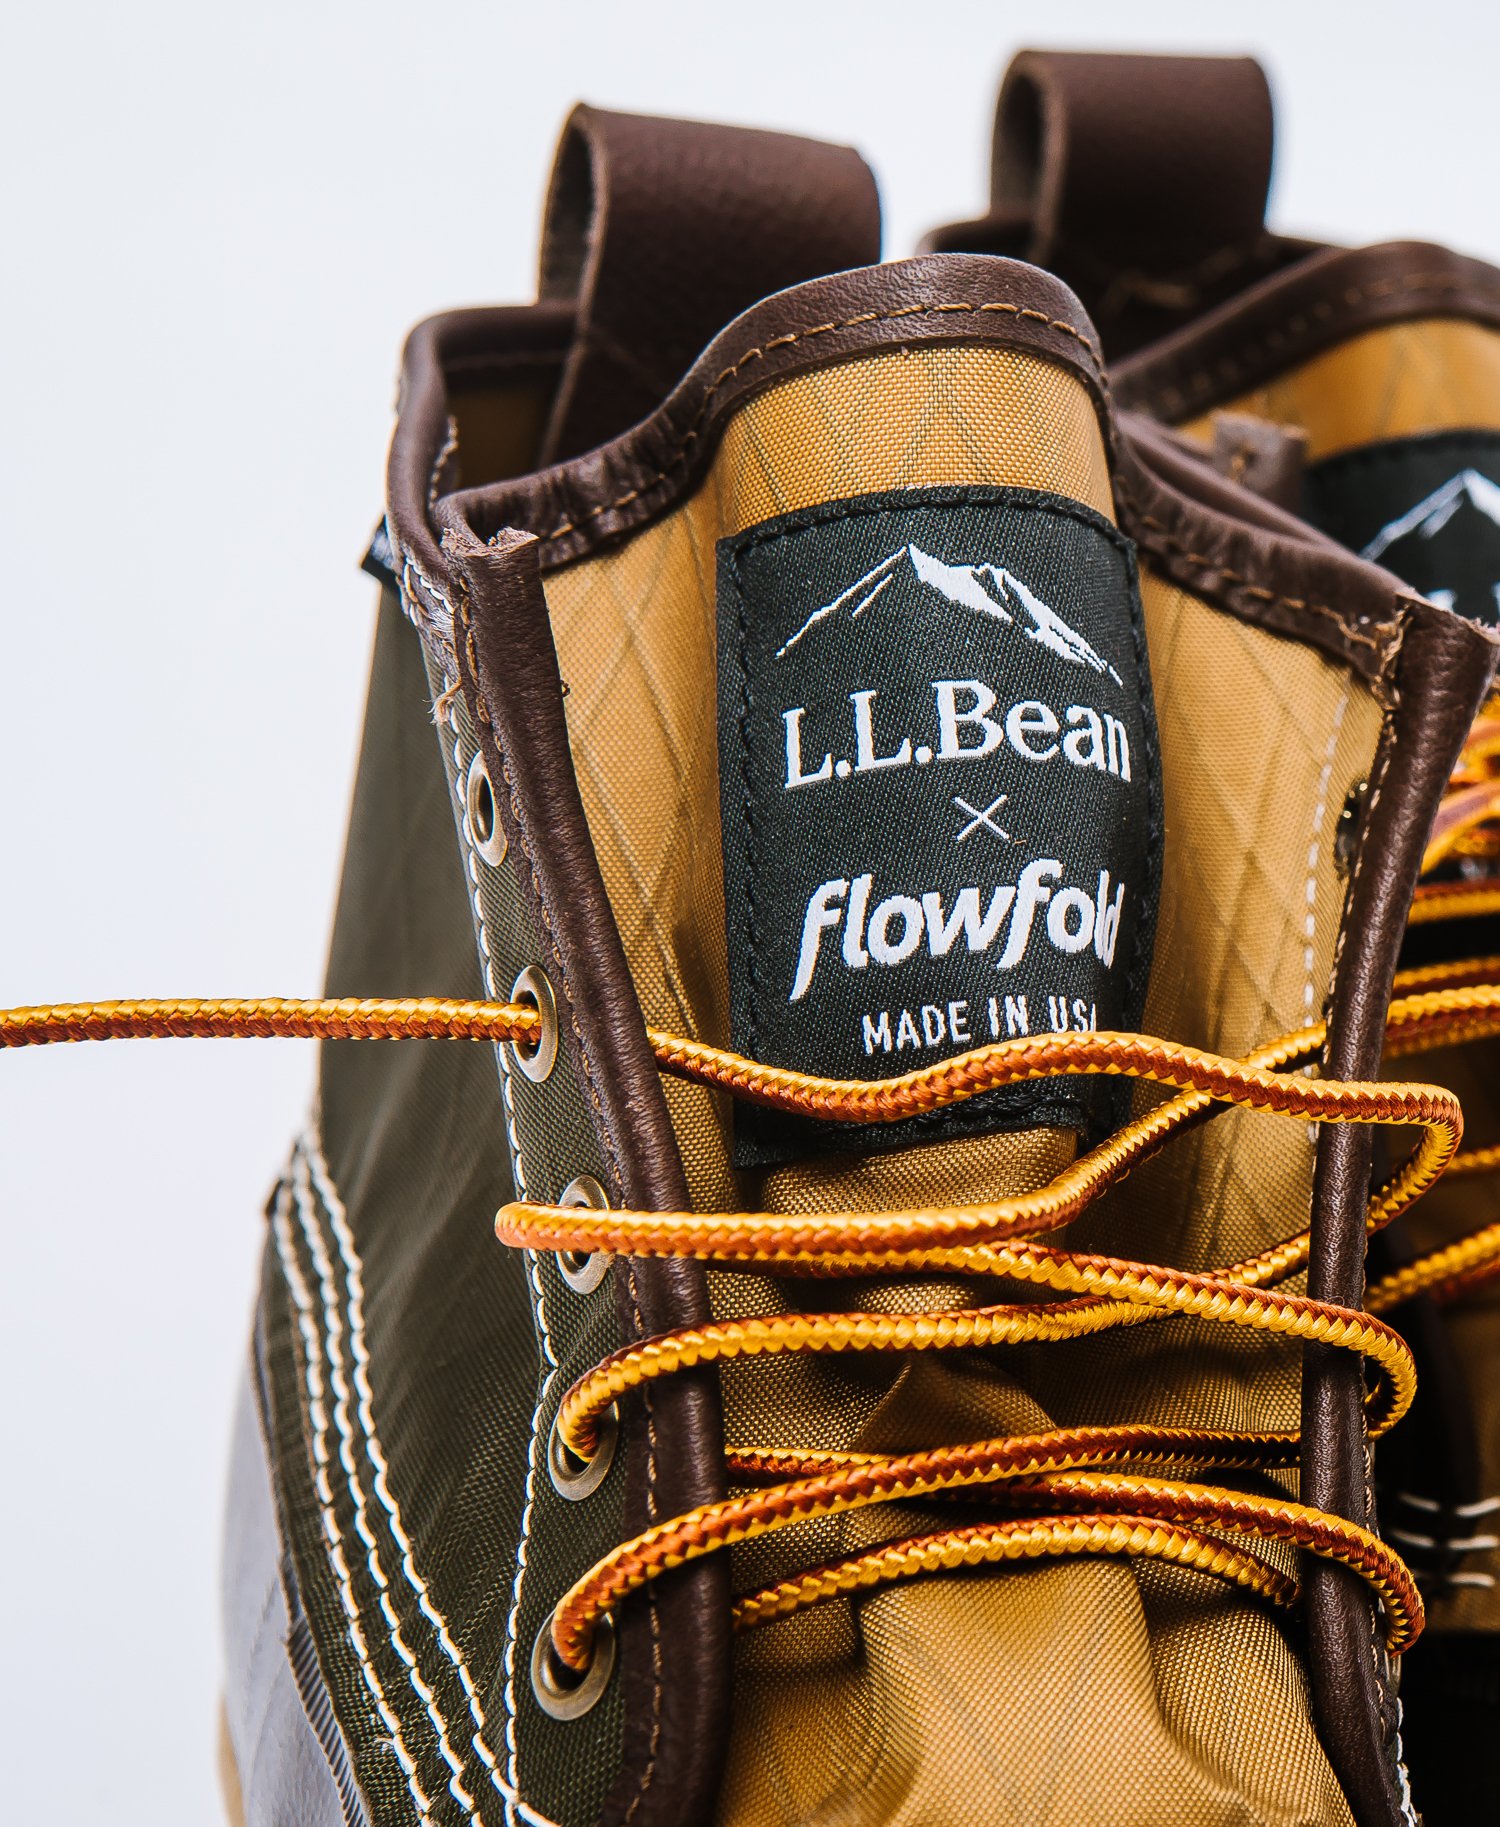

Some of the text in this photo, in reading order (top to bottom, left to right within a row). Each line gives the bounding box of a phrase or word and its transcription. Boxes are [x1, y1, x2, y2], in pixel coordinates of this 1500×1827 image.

[782, 679, 1132, 789] L.L.Bean
[789, 858, 1125, 1000] flowfold
[862, 999, 971, 1056] MADE
[988, 994, 1029, 1036] IN
